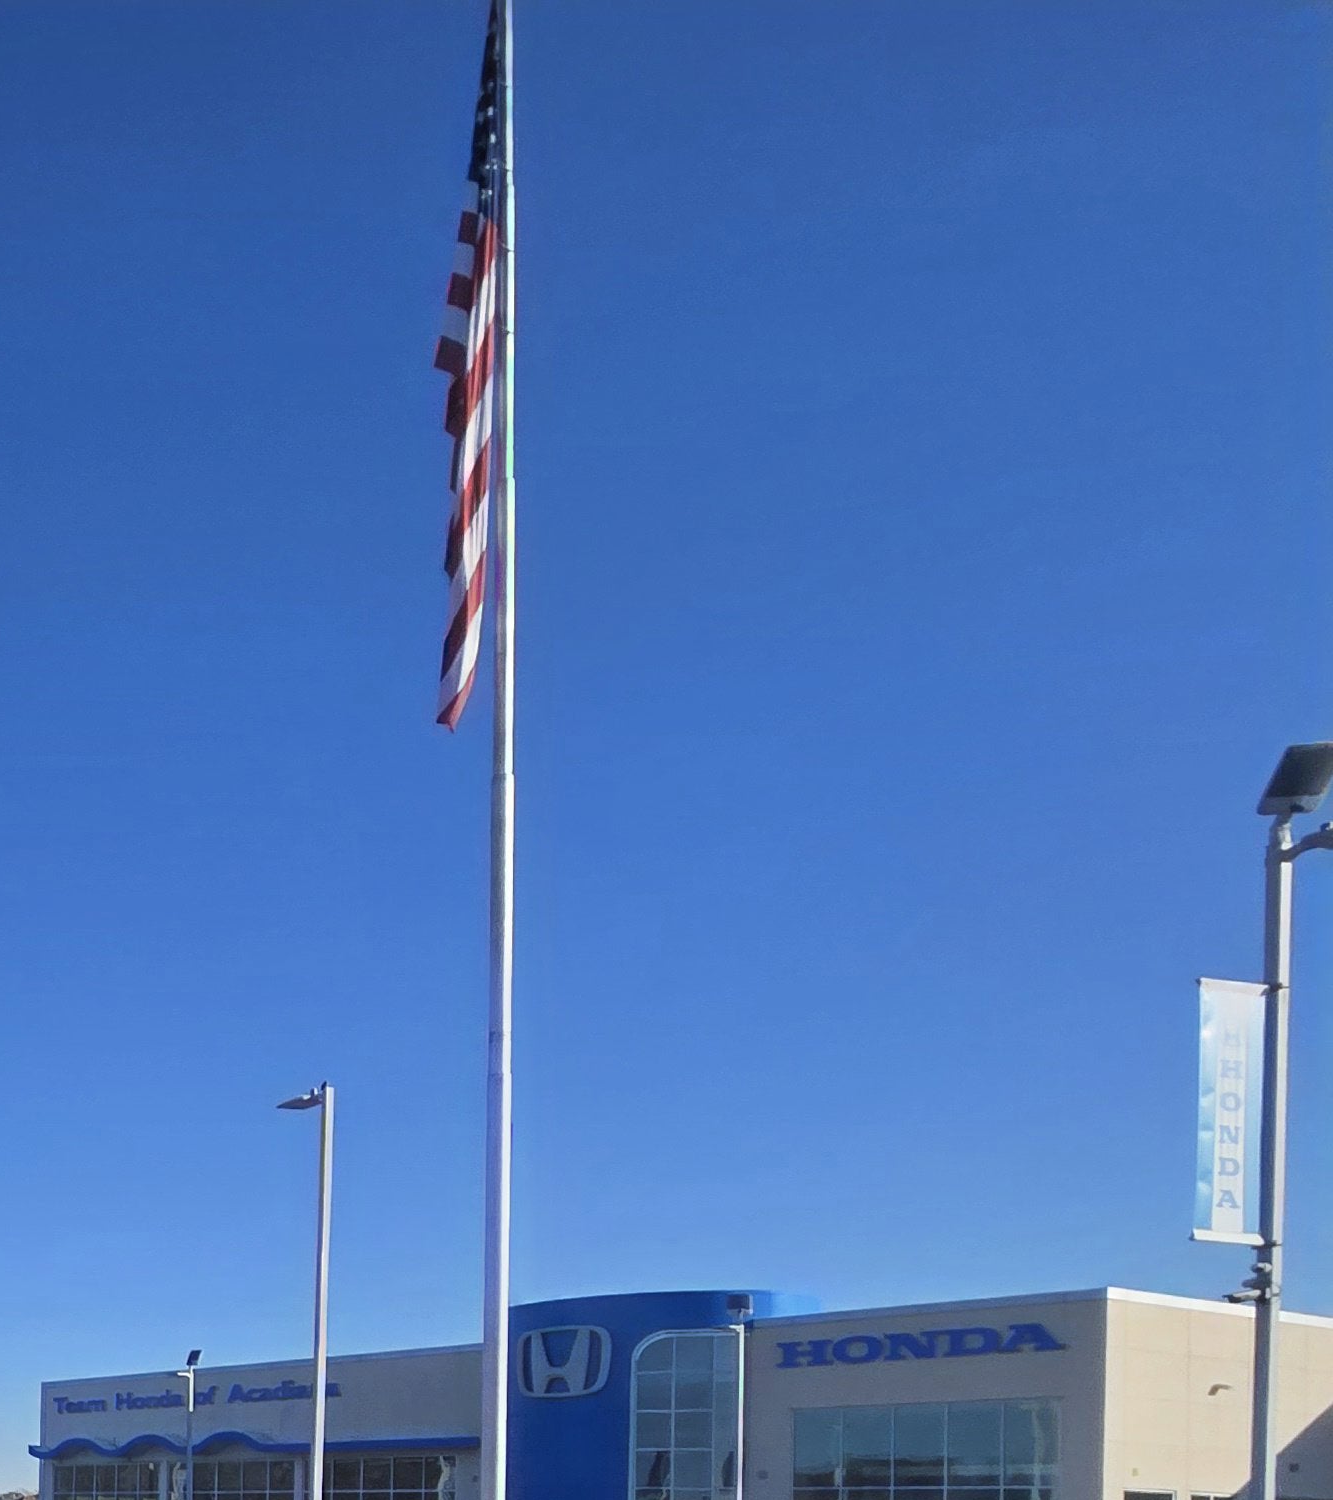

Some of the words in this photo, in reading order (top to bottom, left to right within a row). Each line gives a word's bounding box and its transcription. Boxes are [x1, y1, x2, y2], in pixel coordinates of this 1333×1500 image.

[1215, 1058, 1243, 1210] HONDA
[774, 1322, 1069, 1370] HONDA
[52, 1396, 108, 1415] Team
[115, 1388, 186, 1411] Honda
[192, 1384, 221, 1406] of
[227, 1379, 343, 1403] Acadiaa
